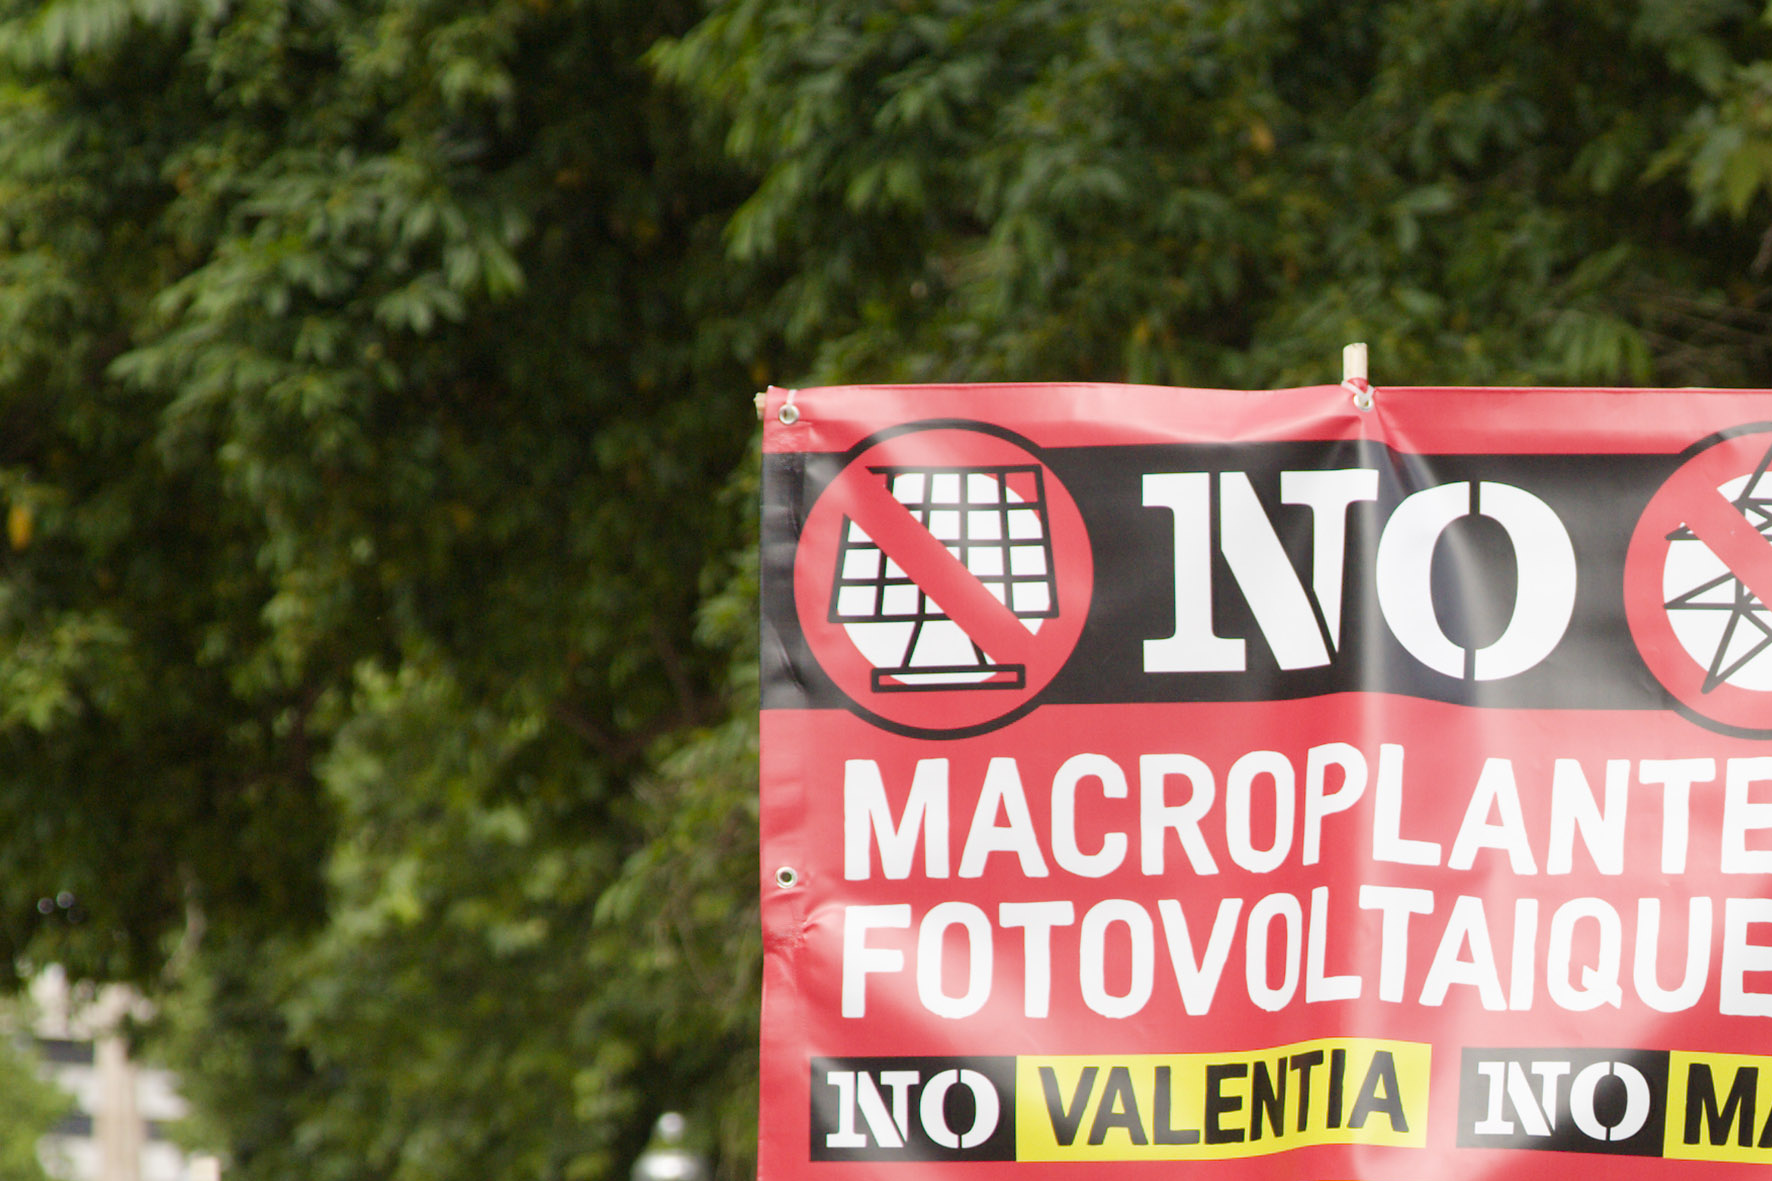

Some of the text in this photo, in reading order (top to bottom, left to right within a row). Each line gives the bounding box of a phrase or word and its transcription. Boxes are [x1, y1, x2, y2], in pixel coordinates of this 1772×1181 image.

[1142, 468, 1577, 681] NO
[825, 1069, 1000, 1150] NO
[1040, 1049, 1411, 1147] VALENTIA
[1475, 1060, 1651, 1141] NO
